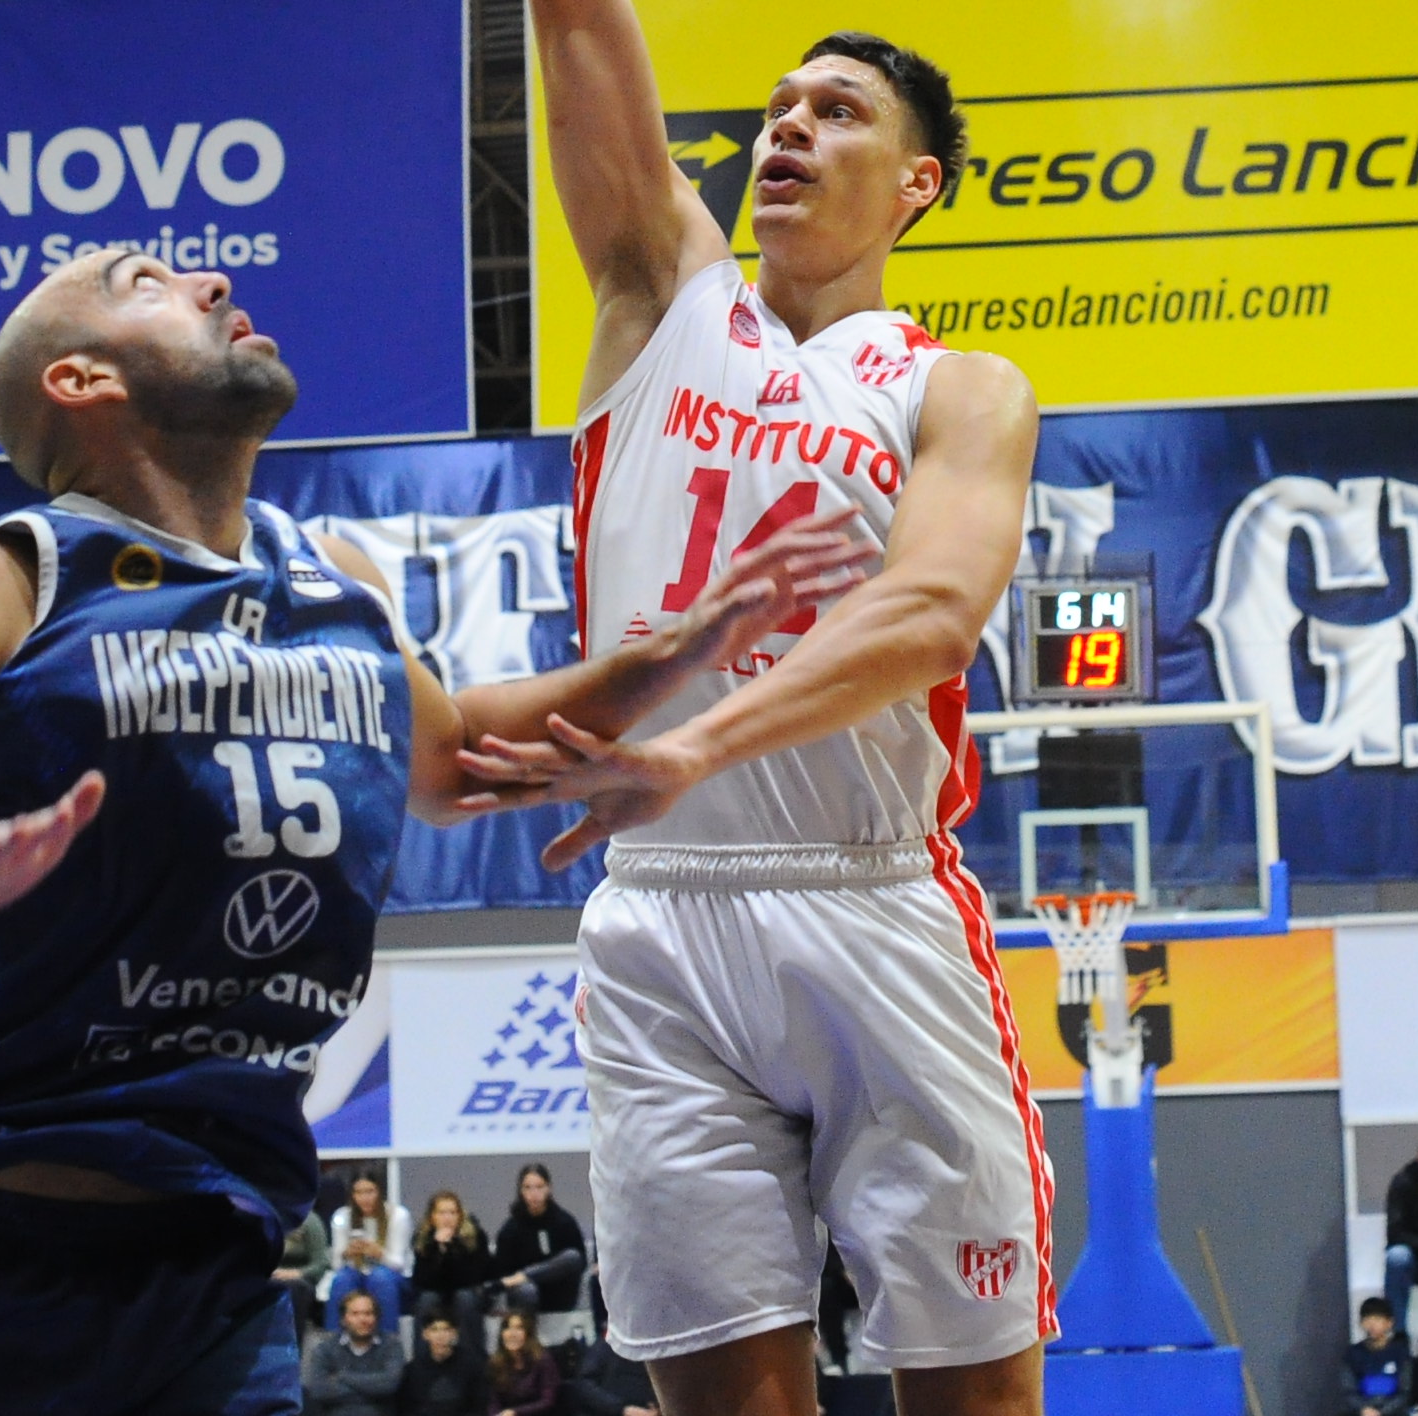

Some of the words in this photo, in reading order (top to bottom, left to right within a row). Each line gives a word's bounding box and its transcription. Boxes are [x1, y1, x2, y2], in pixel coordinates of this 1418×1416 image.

[942, 145, 1155, 209] reso
[664, 386, 899, 495] INSTITUTO
[91, 629, 392, 754] INDEPENDIENTE
[1065, 629, 1121, 690] 19
[213, 741, 341, 859] 15
[118, 959, 363, 1018] Venerand
